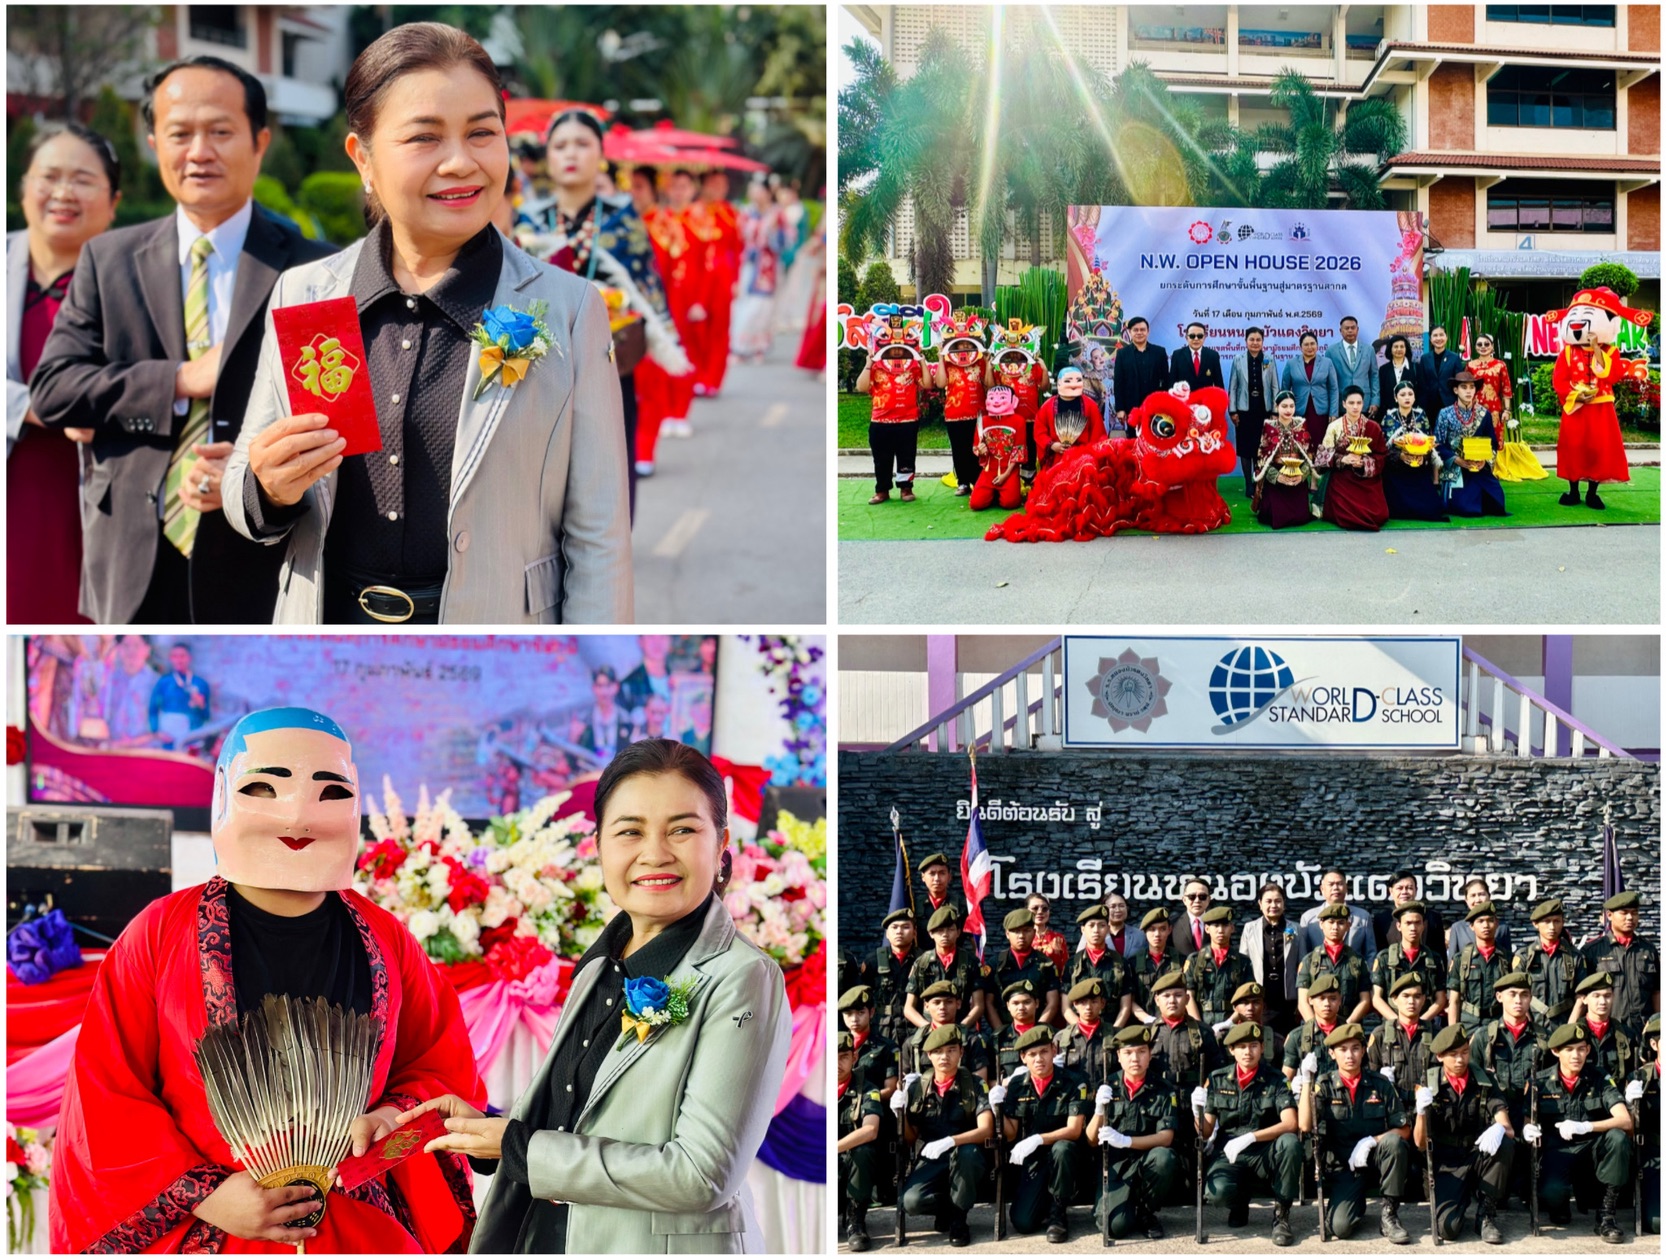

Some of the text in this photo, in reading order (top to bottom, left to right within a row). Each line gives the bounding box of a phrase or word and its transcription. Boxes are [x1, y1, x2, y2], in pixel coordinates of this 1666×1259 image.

[1140, 254, 1361, 270] N.W. OPEN HOUSE 2026
[1212, 310, 1220, 318] 17
[1382, 709, 1443, 723] SCHOOL
[1086, 800, 1103, 829] สู่
